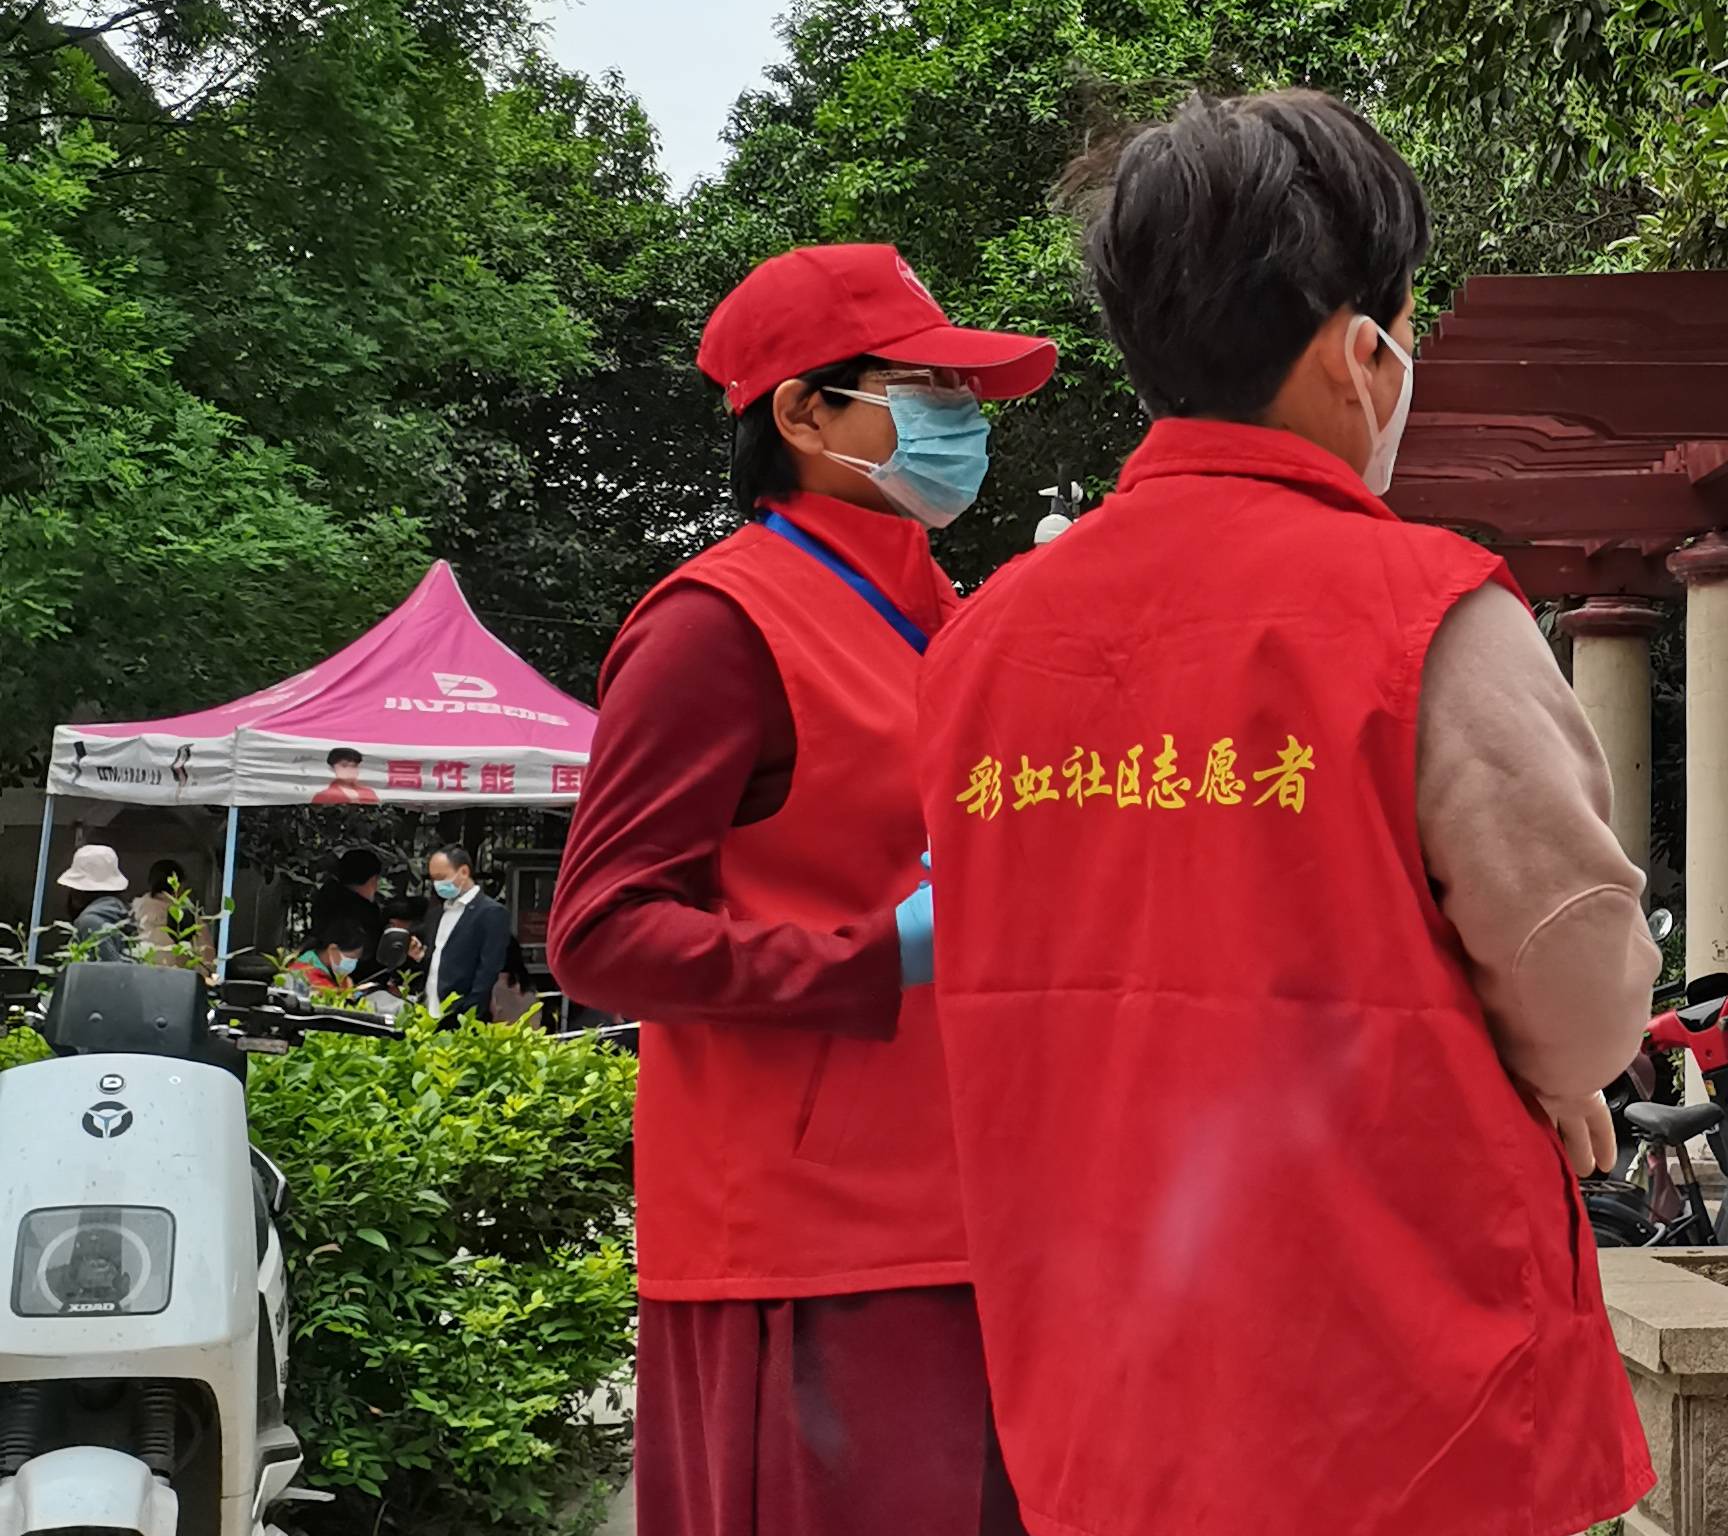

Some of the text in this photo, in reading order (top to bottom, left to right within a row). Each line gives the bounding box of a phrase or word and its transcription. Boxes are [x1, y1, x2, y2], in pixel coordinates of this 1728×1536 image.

[386, 759, 516, 794] 高性能
[956, 734, 1315, 821] 彩虹社区志愿者
